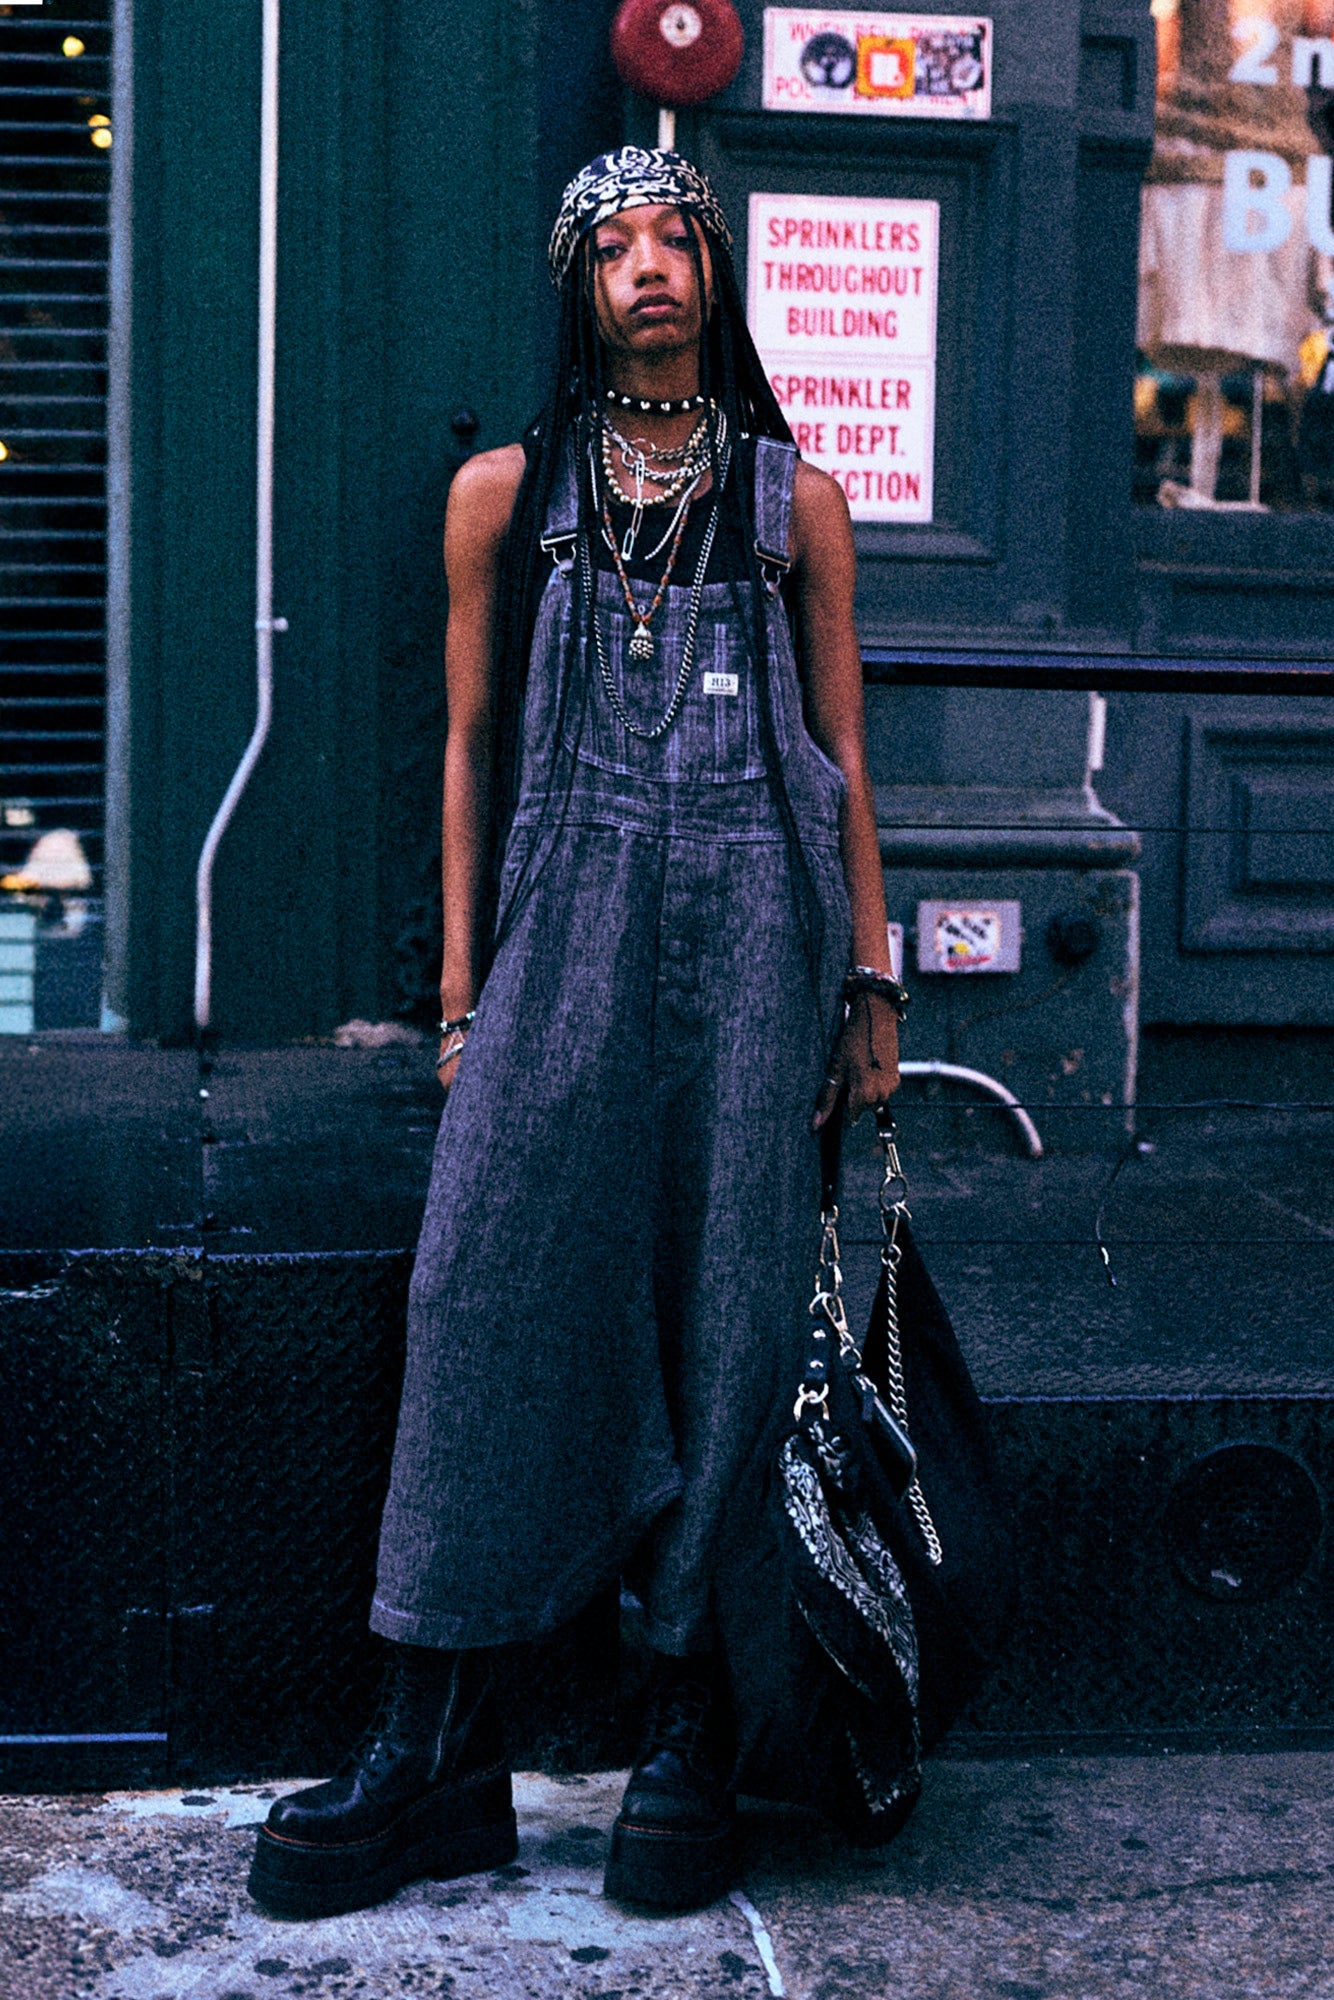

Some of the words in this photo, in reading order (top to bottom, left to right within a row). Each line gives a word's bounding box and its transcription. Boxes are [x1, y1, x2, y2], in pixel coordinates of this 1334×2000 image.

[768, 216, 920, 252] SPRINKLERS
[764, 261, 922, 295] THROUGHOUT
[787, 307, 897, 338] BUILDING
[771, 374, 911, 410] SPRINKLER
[790, 422, 826, 454] RE
[837, 423, 906, 456] DEPT.
